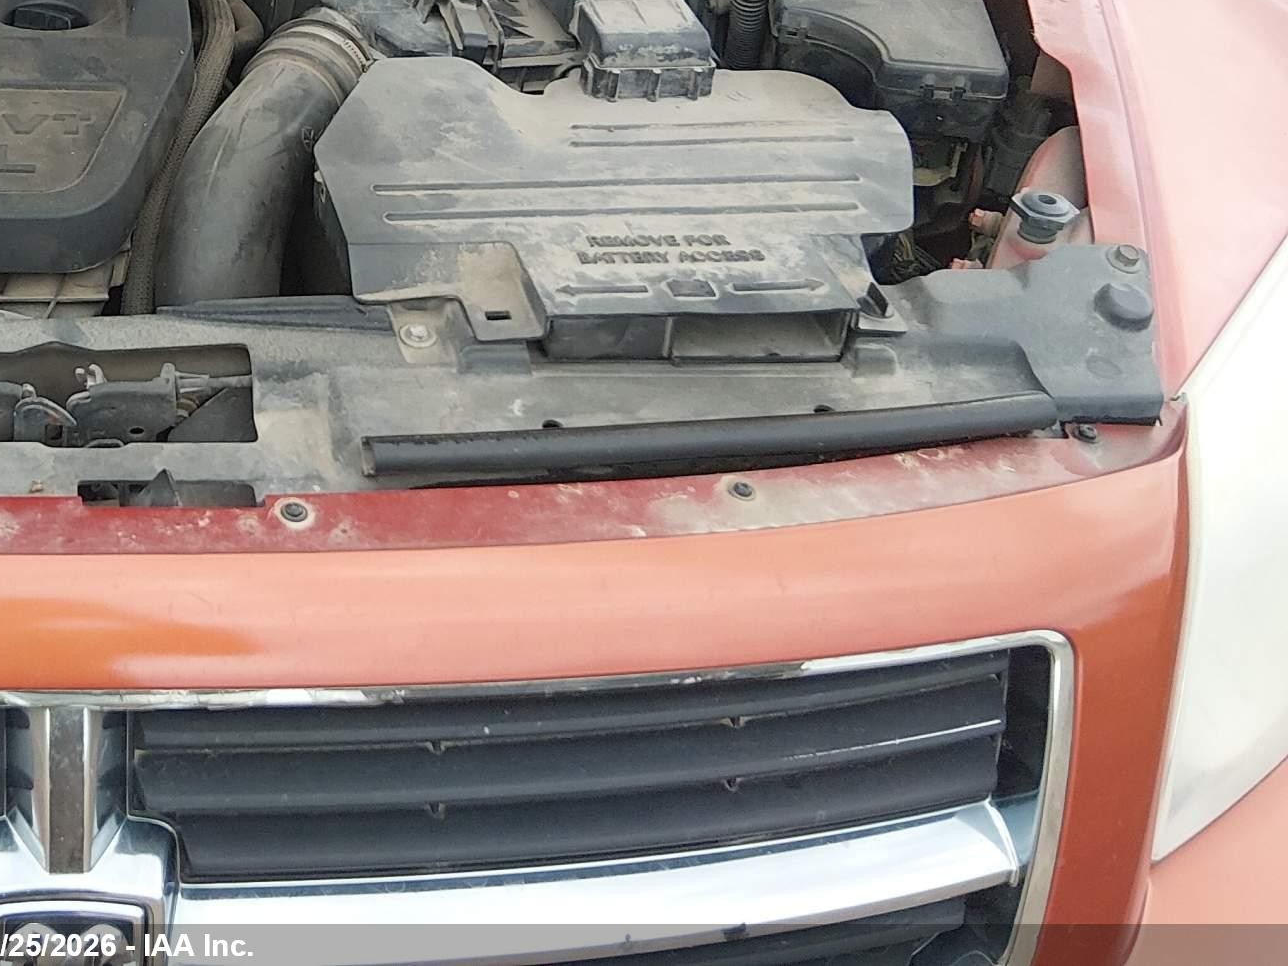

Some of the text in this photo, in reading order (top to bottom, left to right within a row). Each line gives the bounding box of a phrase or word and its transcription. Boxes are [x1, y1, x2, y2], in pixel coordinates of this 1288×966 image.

[585, 234, 731, 248] REMOVE FOR
[576, 249, 765, 265] BATTERY ACCESS
